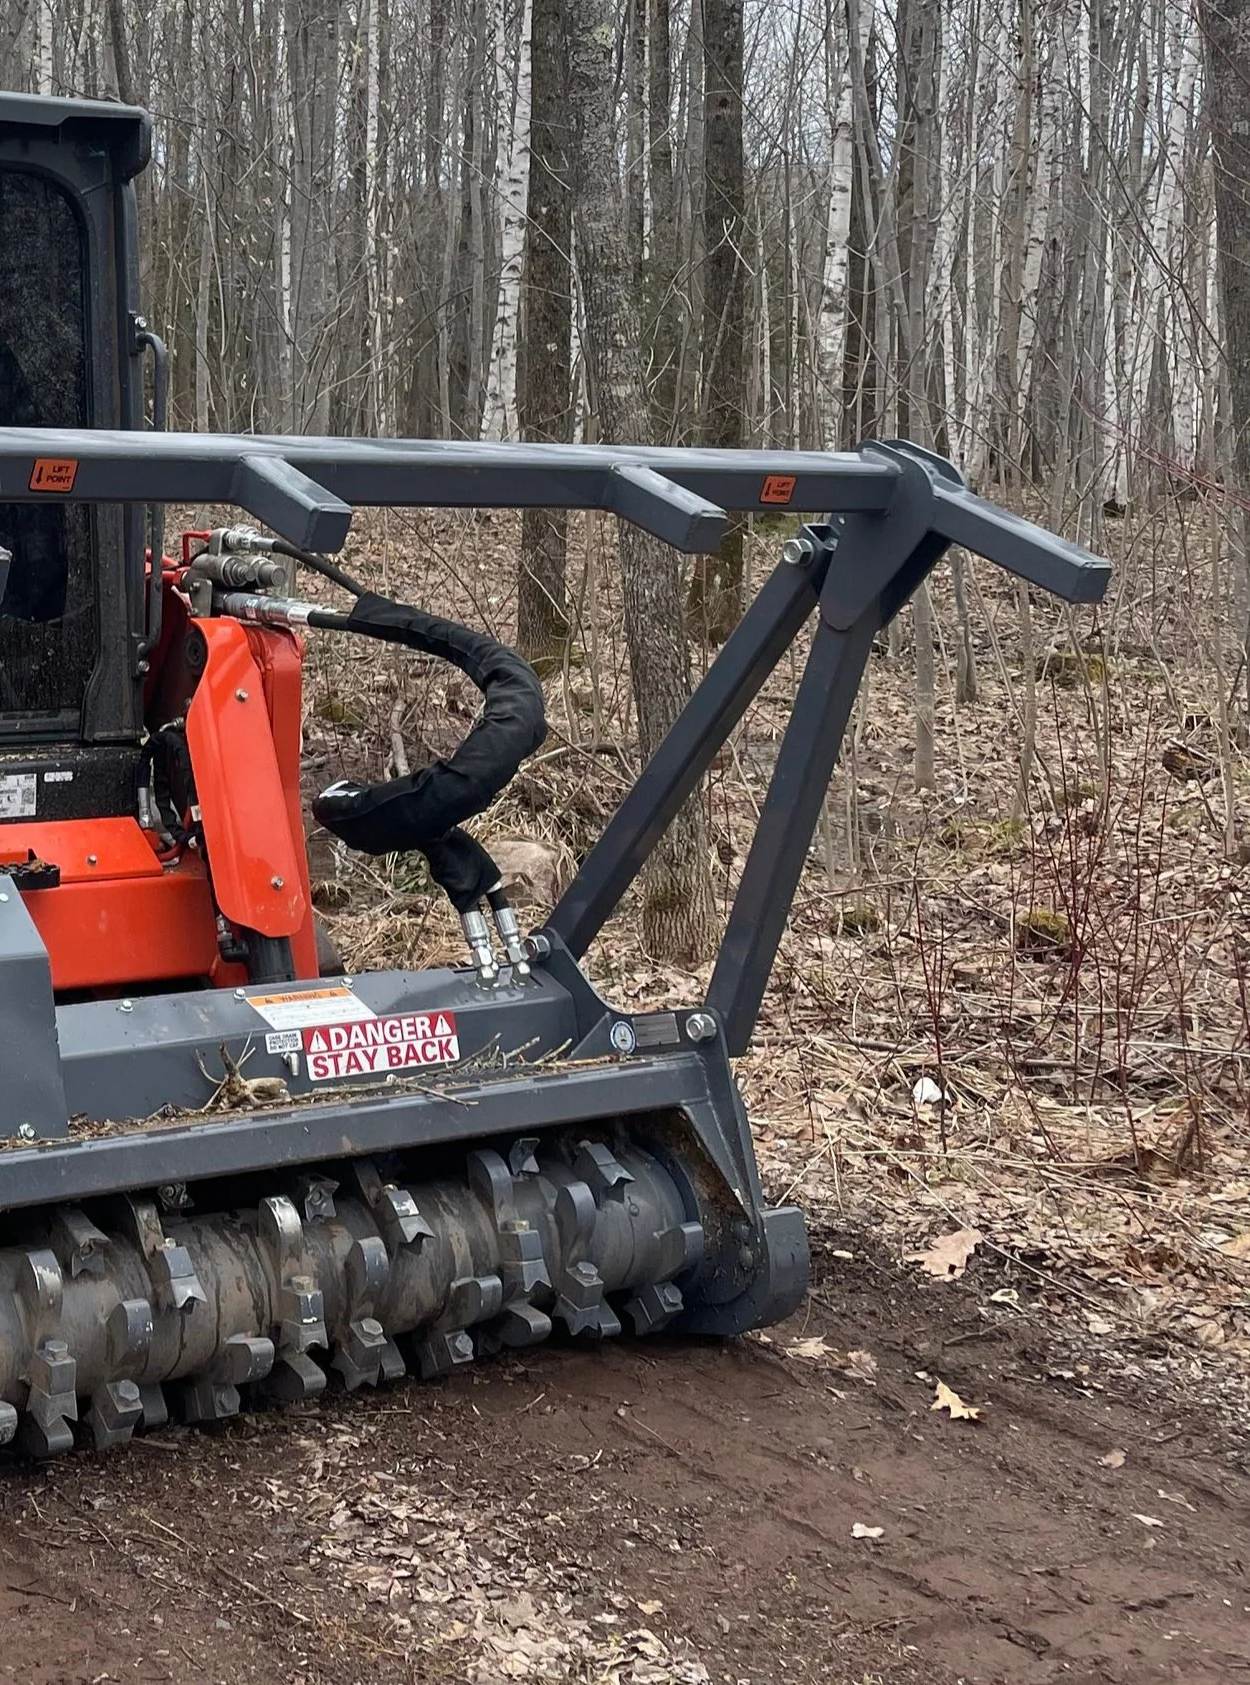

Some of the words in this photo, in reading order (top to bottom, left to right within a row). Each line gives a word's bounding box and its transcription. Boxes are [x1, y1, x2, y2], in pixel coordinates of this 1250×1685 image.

[46, 475, 71, 483] POINT
[53, 466, 70, 474] LIFT
[329, 1016, 431, 1051] DANGER
[313, 1045, 380, 1078] STAY
[386, 1037, 455, 1067] BACK
